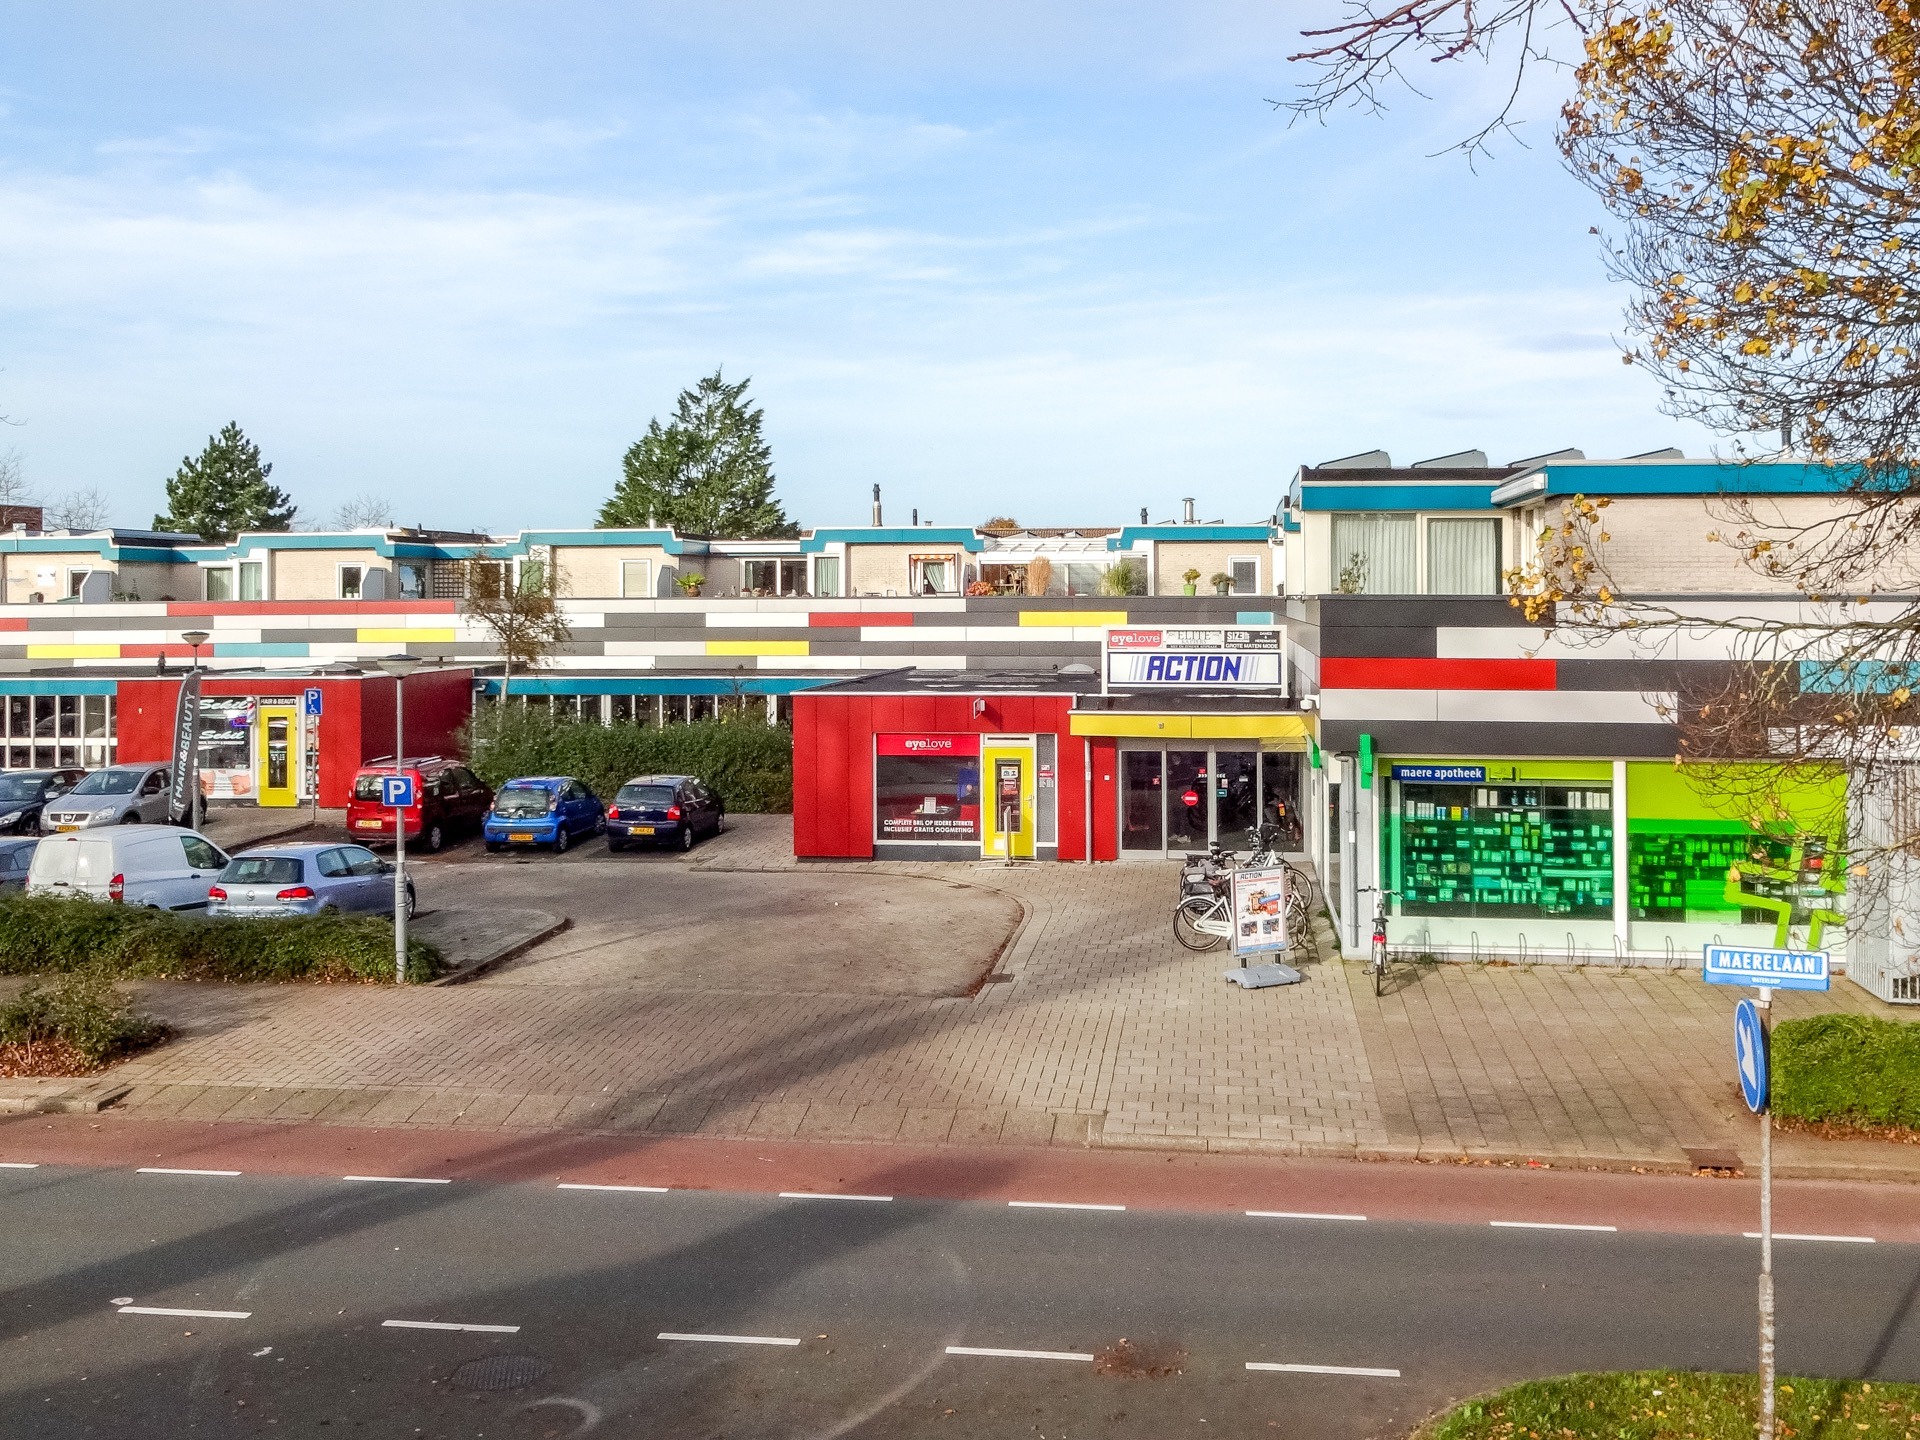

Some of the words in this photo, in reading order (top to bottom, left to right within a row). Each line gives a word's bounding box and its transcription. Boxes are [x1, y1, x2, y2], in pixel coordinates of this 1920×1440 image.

[1111, 632, 1161, 645] eyelove
[1146, 655, 1242, 681] ACTION
[308, 690, 318, 705] P
[905, 738, 952, 750] eyelove
[1401, 768, 1432, 777] maere
[1434, 767, 1482, 780] apotheek
[388, 780, 406, 803] P
[1240, 872, 1263, 880] ACTION
[1719, 951, 1816, 974] MAERELAAN
